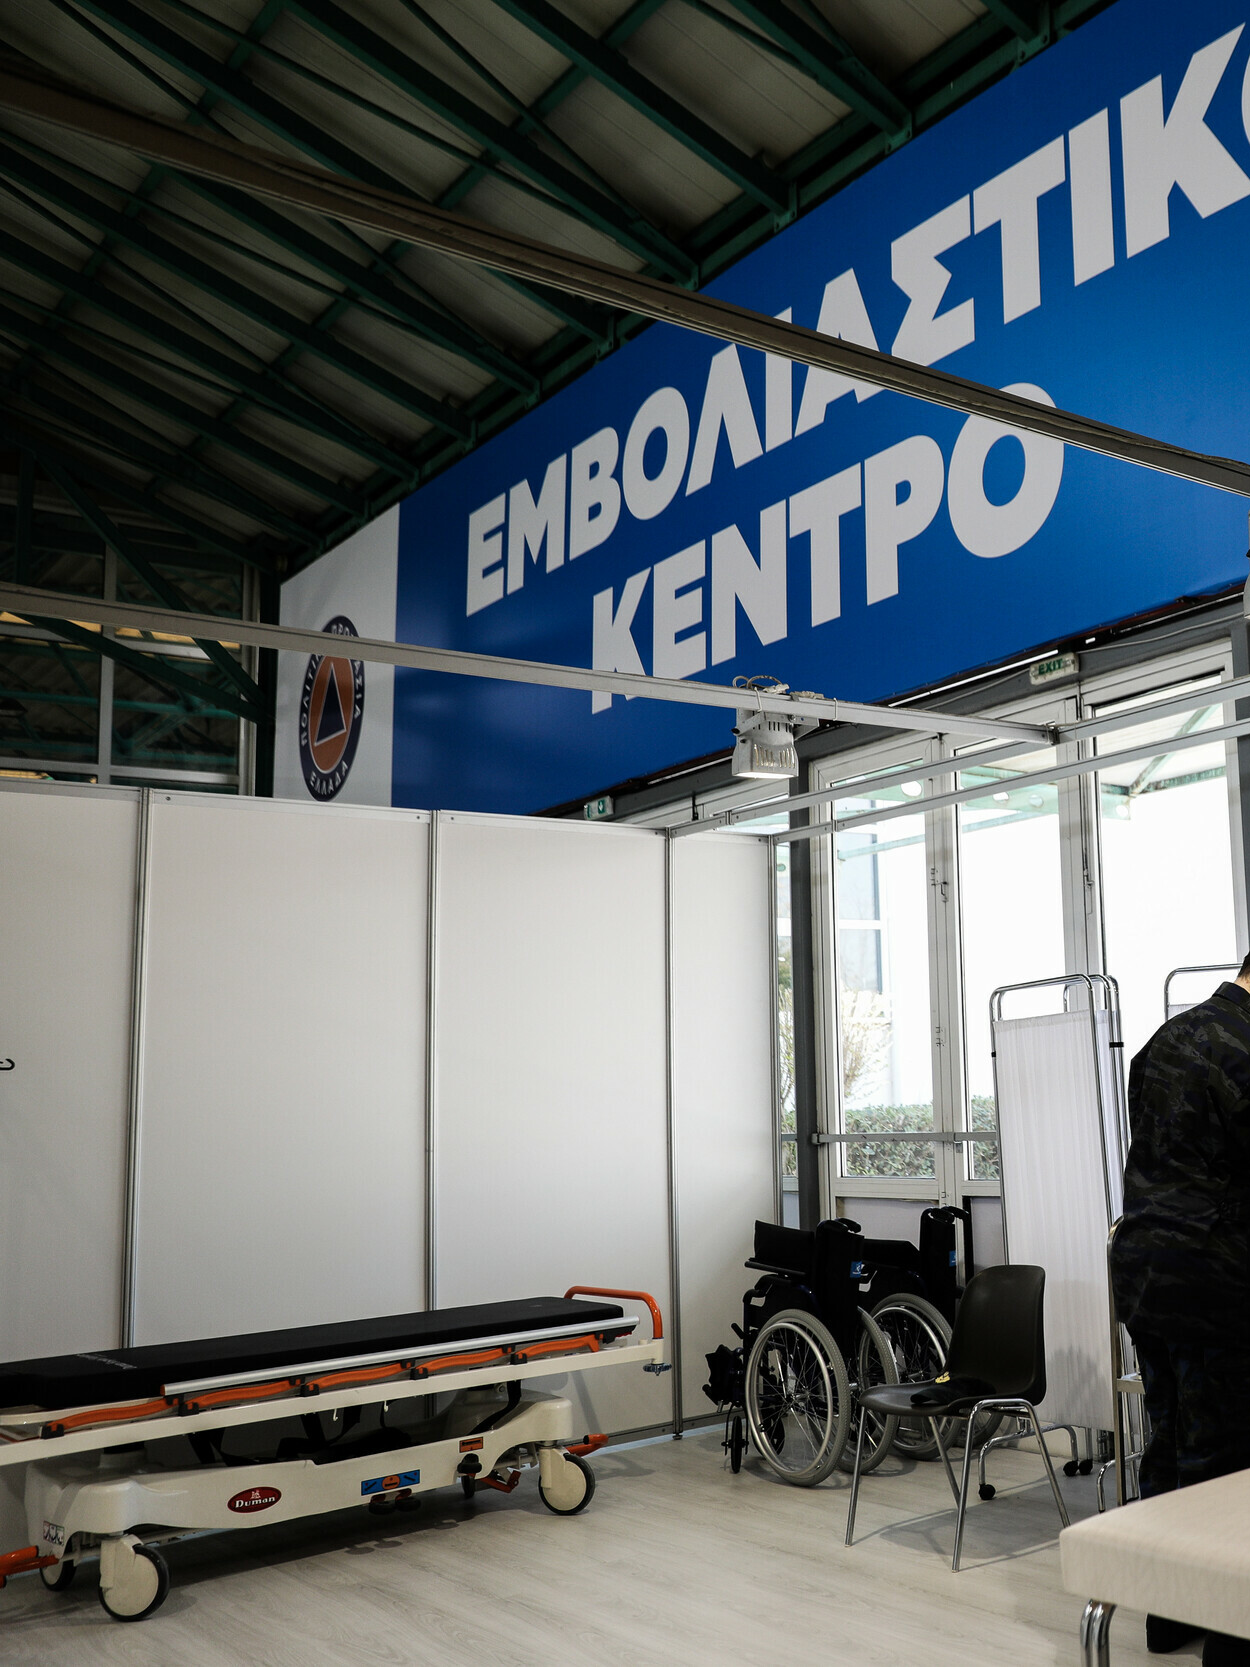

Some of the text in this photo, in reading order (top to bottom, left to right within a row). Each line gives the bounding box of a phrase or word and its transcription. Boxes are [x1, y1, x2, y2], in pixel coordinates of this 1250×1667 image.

[592, 382, 1064, 714] ΚΕΝΤΡΟ
[331, 623, 363, 720] ΠΡΟΑΣΙΑ
[1038, 658, 1064, 675] EXIT
[310, 760, 348, 796] ΕΛΛΑΔΑ
[235, 1496, 276, 1509] Duman
